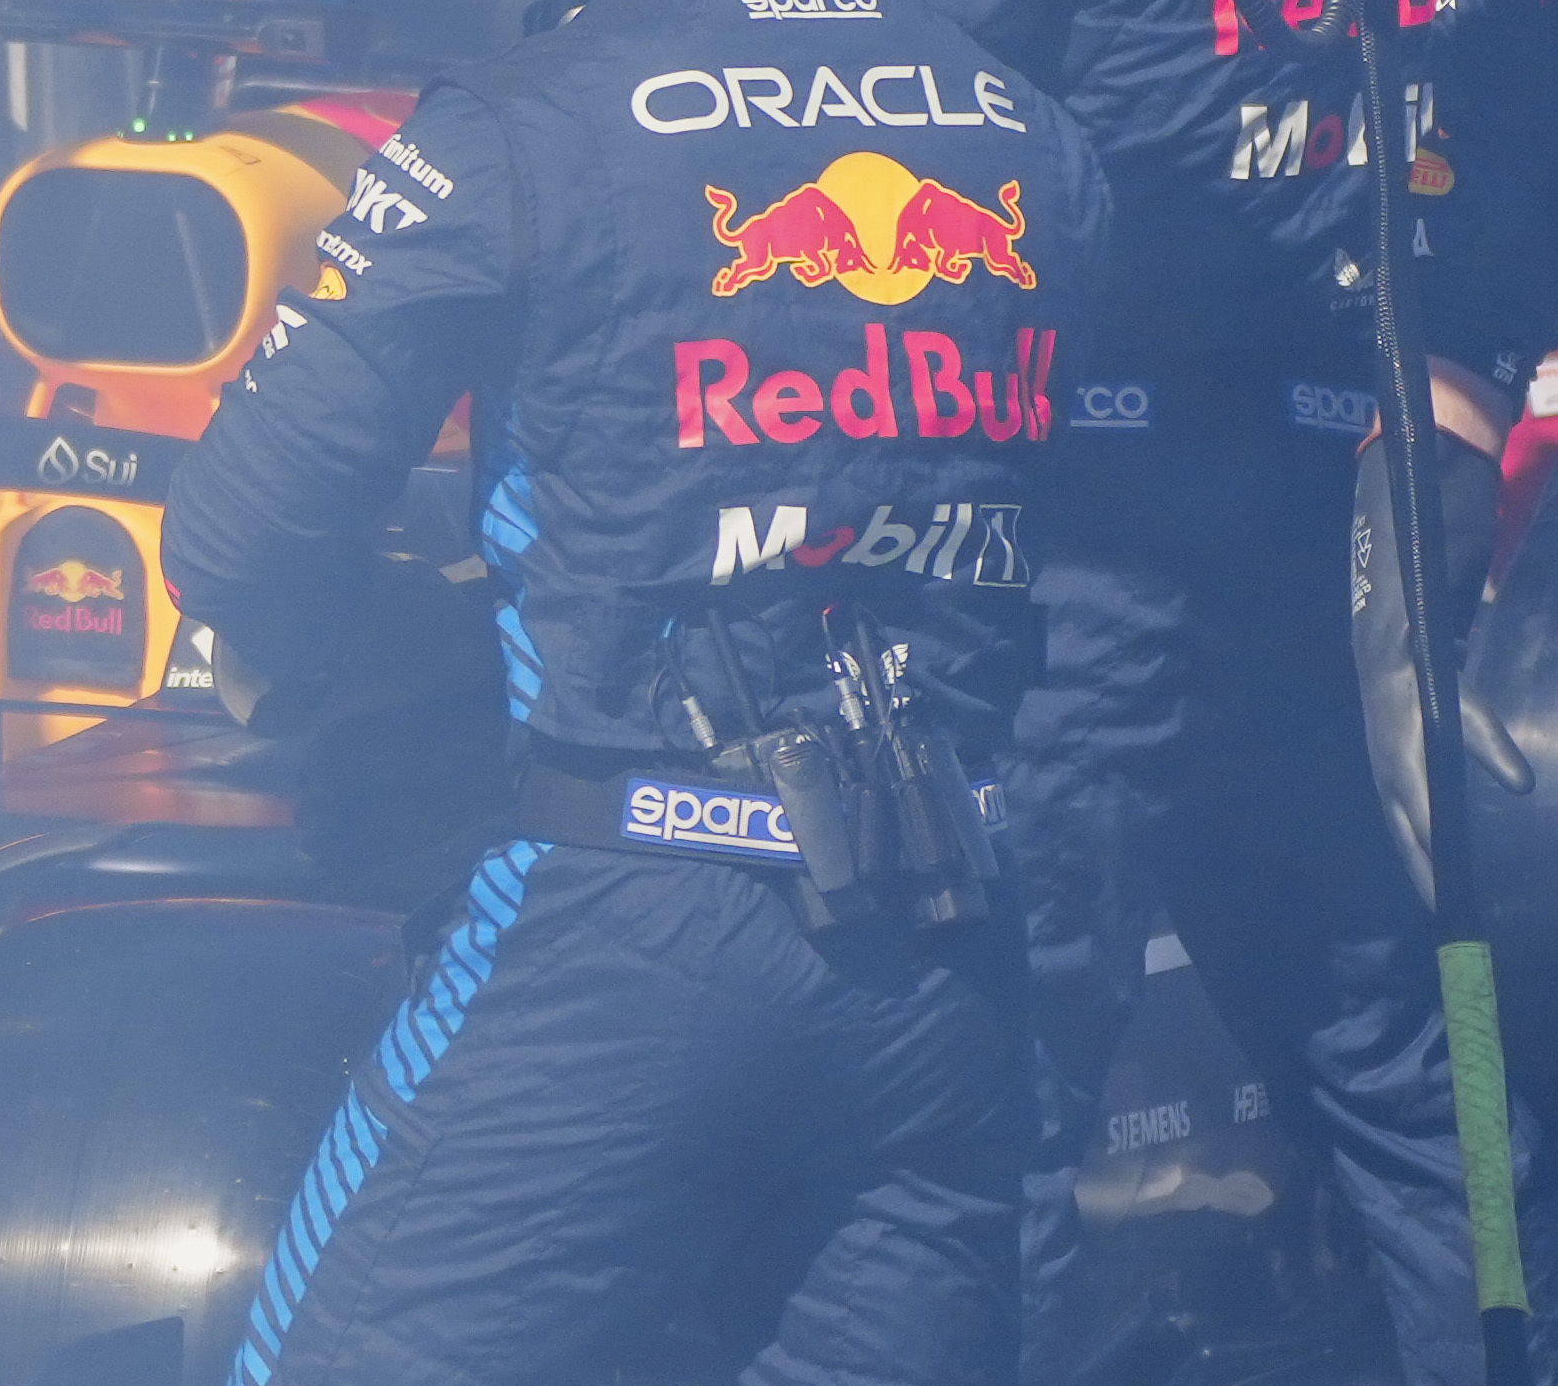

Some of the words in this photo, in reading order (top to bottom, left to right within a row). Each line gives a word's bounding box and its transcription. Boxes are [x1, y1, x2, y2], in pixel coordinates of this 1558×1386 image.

[630, 64, 1028, 135] ORACLE
[673, 321, 900, 449] Red
[901, 326, 1057, 443] Bull
[85, 450, 138, 486] Sui
[709, 502, 974, 587] Mobil
[74, 608, 123, 636] Bull
[1107, 1100, 1192, 1156] SIEMENS
